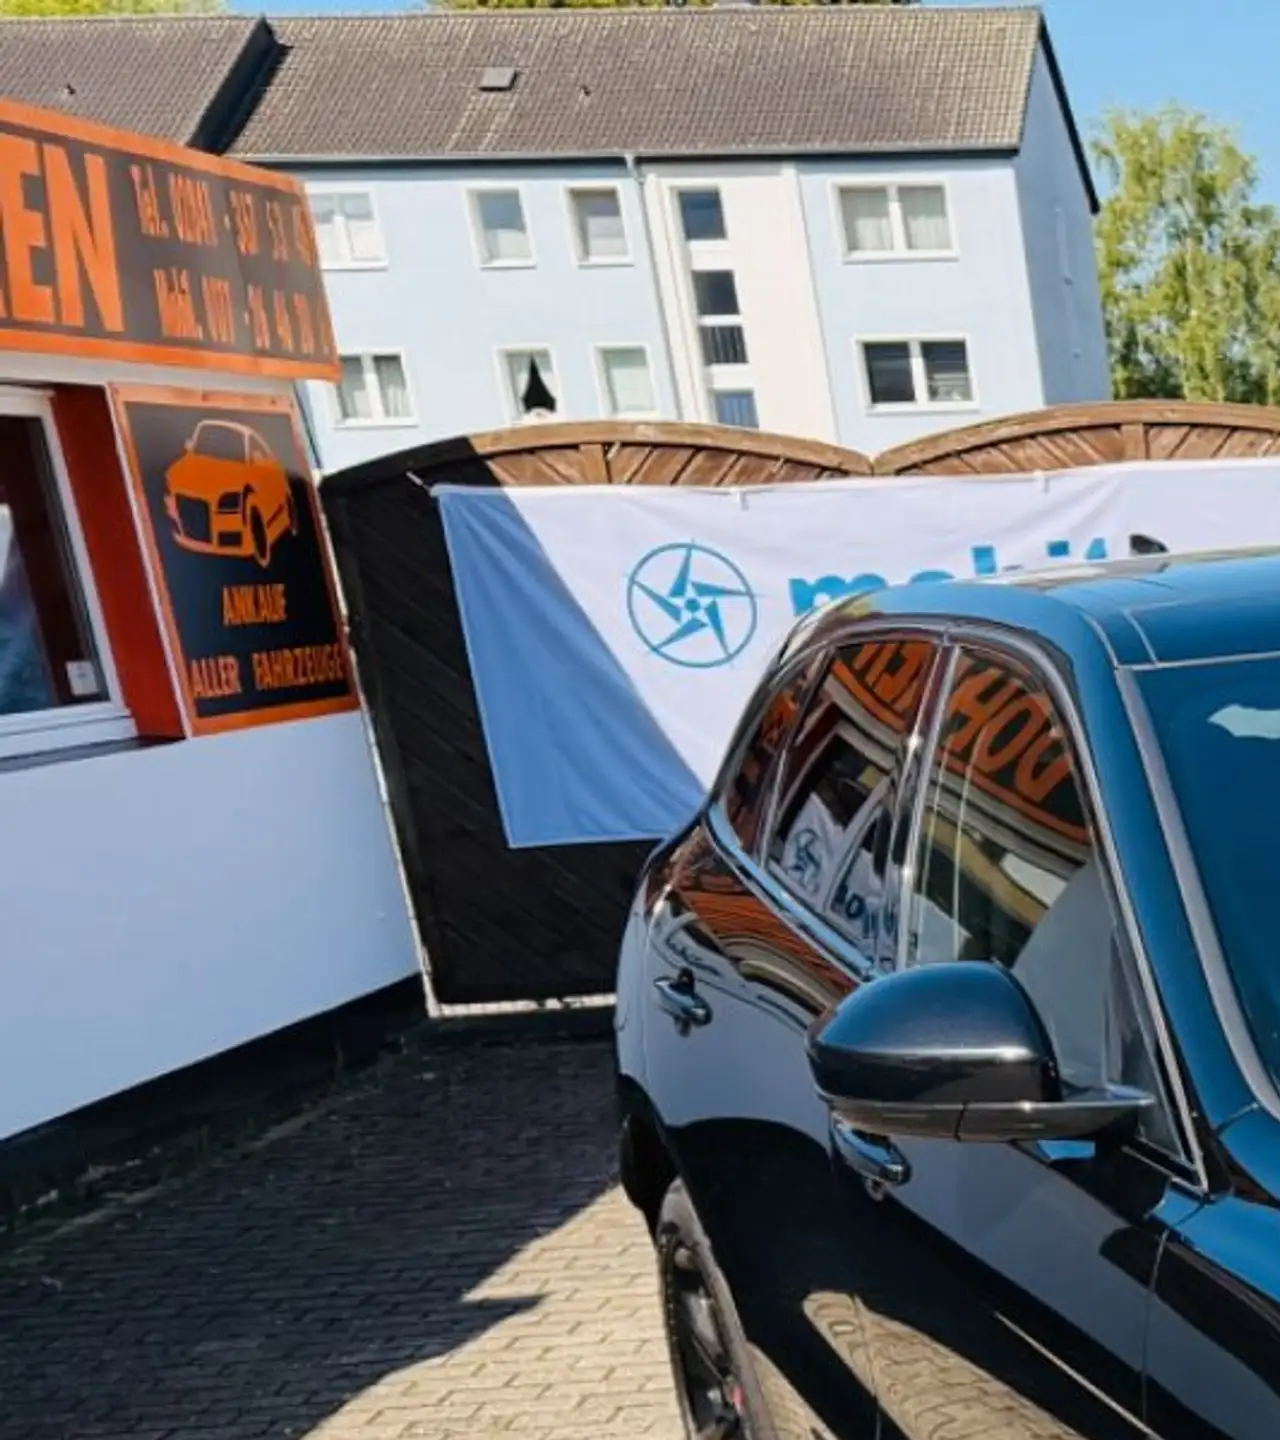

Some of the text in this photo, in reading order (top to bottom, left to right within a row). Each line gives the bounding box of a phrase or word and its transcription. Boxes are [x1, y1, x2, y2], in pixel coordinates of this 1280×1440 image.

[0, 130, 124, 333] EN
[222, 583, 287, 627] ANKAUF
[190, 643, 346, 698] ALLER FAHRZEUGE
